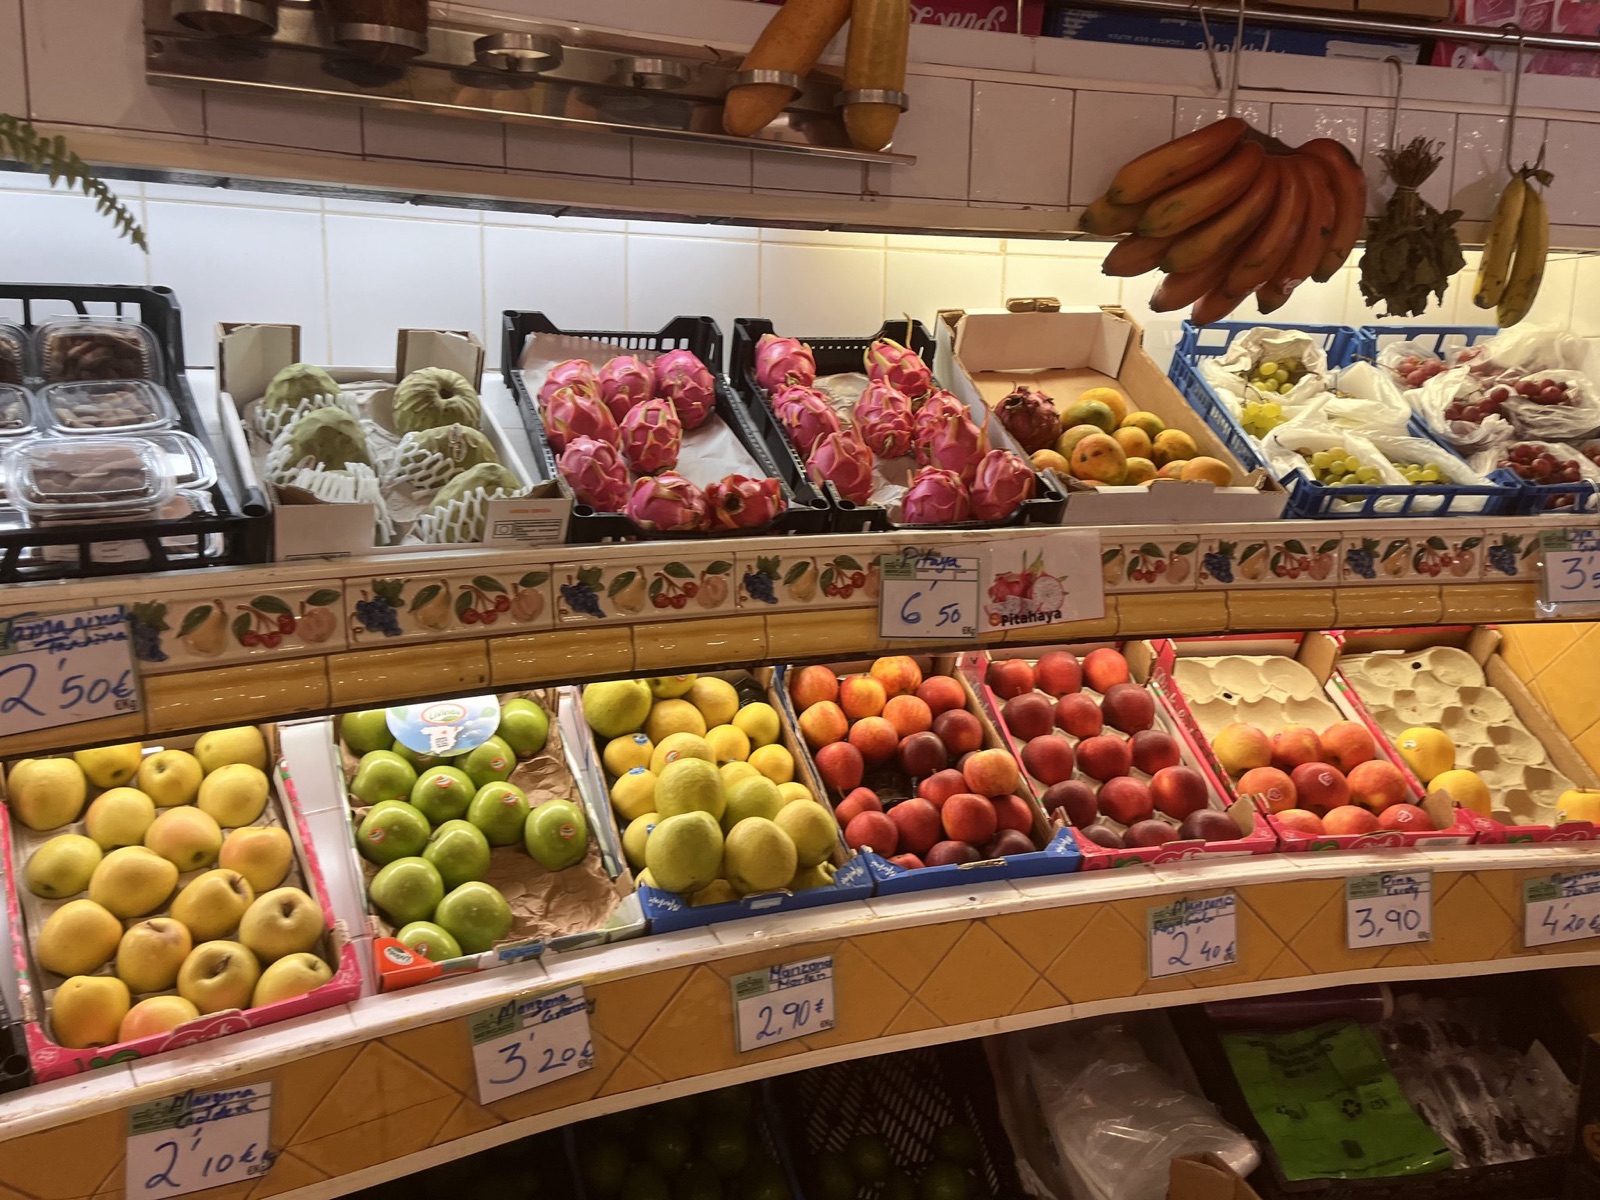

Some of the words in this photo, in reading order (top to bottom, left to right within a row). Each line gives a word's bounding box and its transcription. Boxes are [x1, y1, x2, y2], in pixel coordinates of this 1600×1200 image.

[1000, 609, 1063, 627] Pitahaya
[1354, 907, 1422, 939] 3,90
[755, 998, 825, 1041] 2,90€
[488, 1032, 596, 1085] 3'20€
